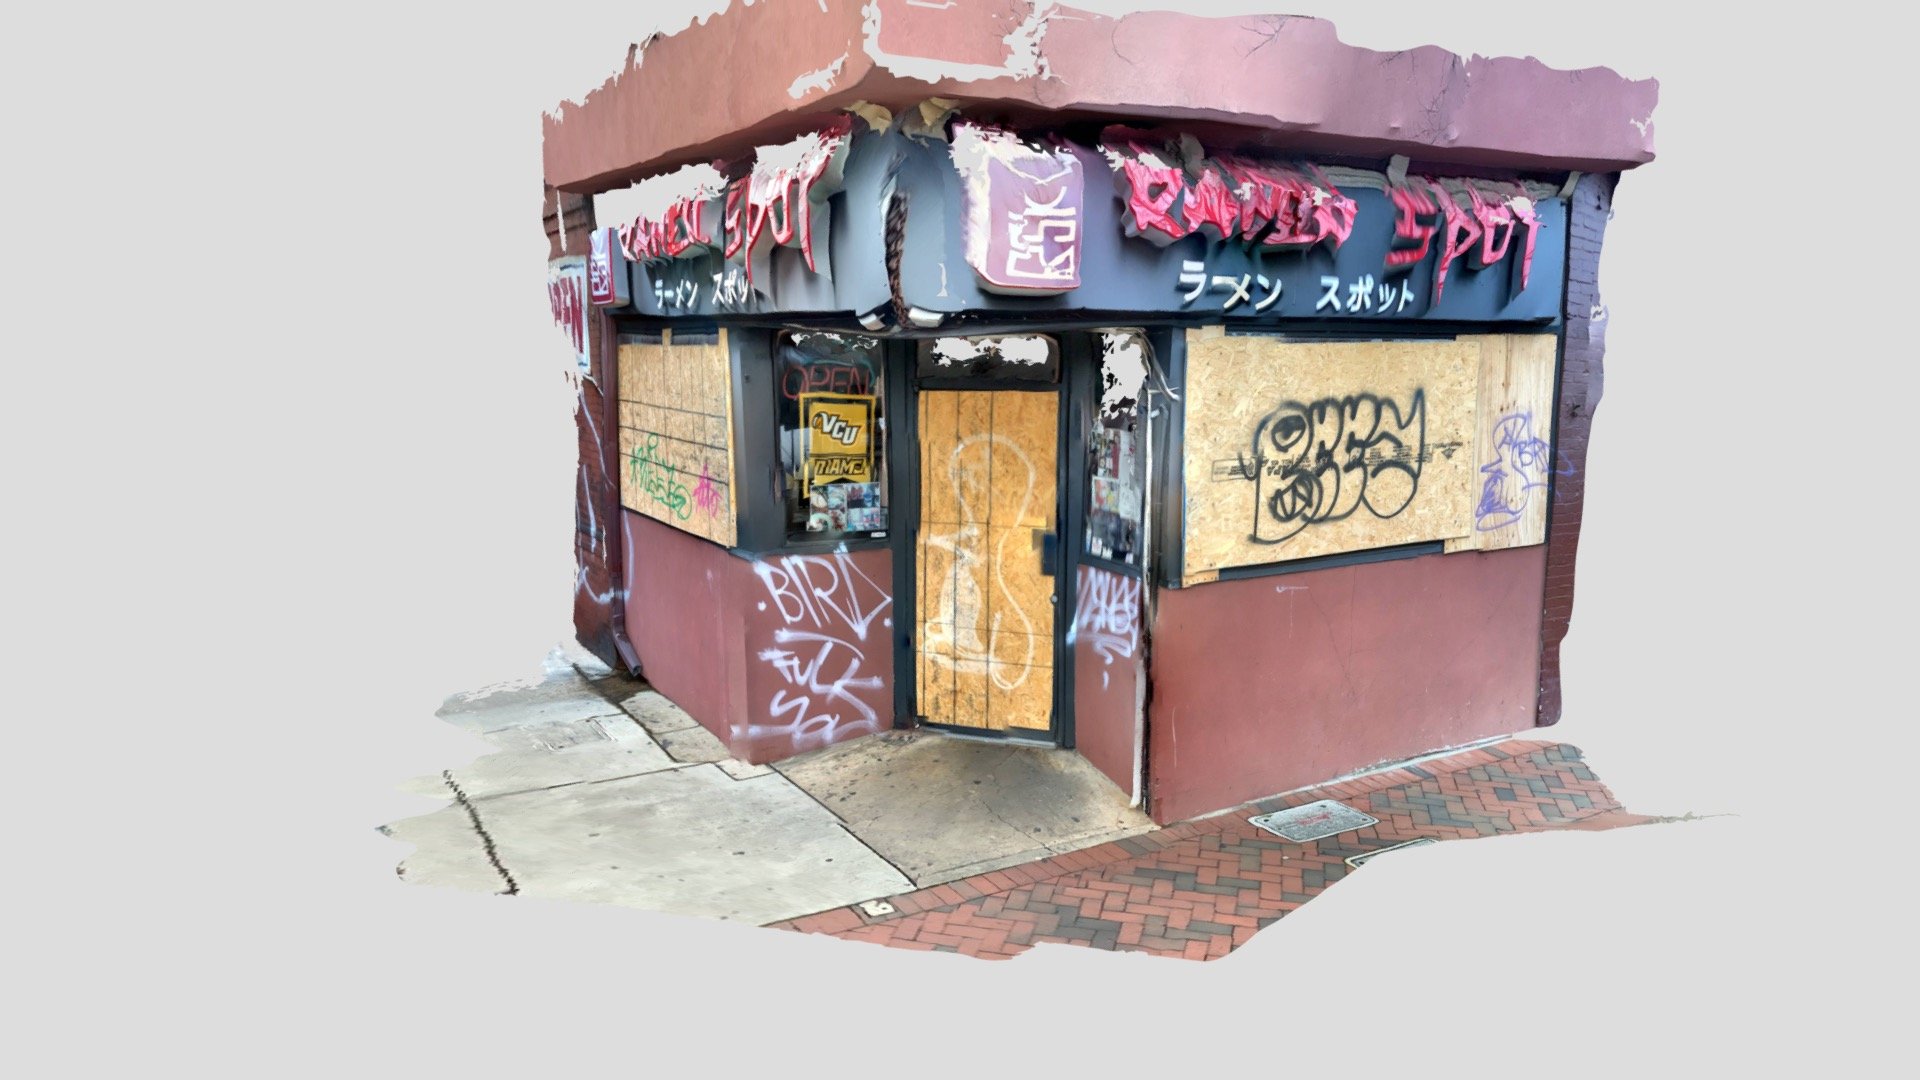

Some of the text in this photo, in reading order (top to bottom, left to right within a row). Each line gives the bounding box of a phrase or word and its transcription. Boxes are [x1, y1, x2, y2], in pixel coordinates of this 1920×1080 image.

[654, 279, 698, 309] ラーメン
[1178, 259, 1415, 313] ラーメン スポット
[813, 411, 861, 445] VCU
